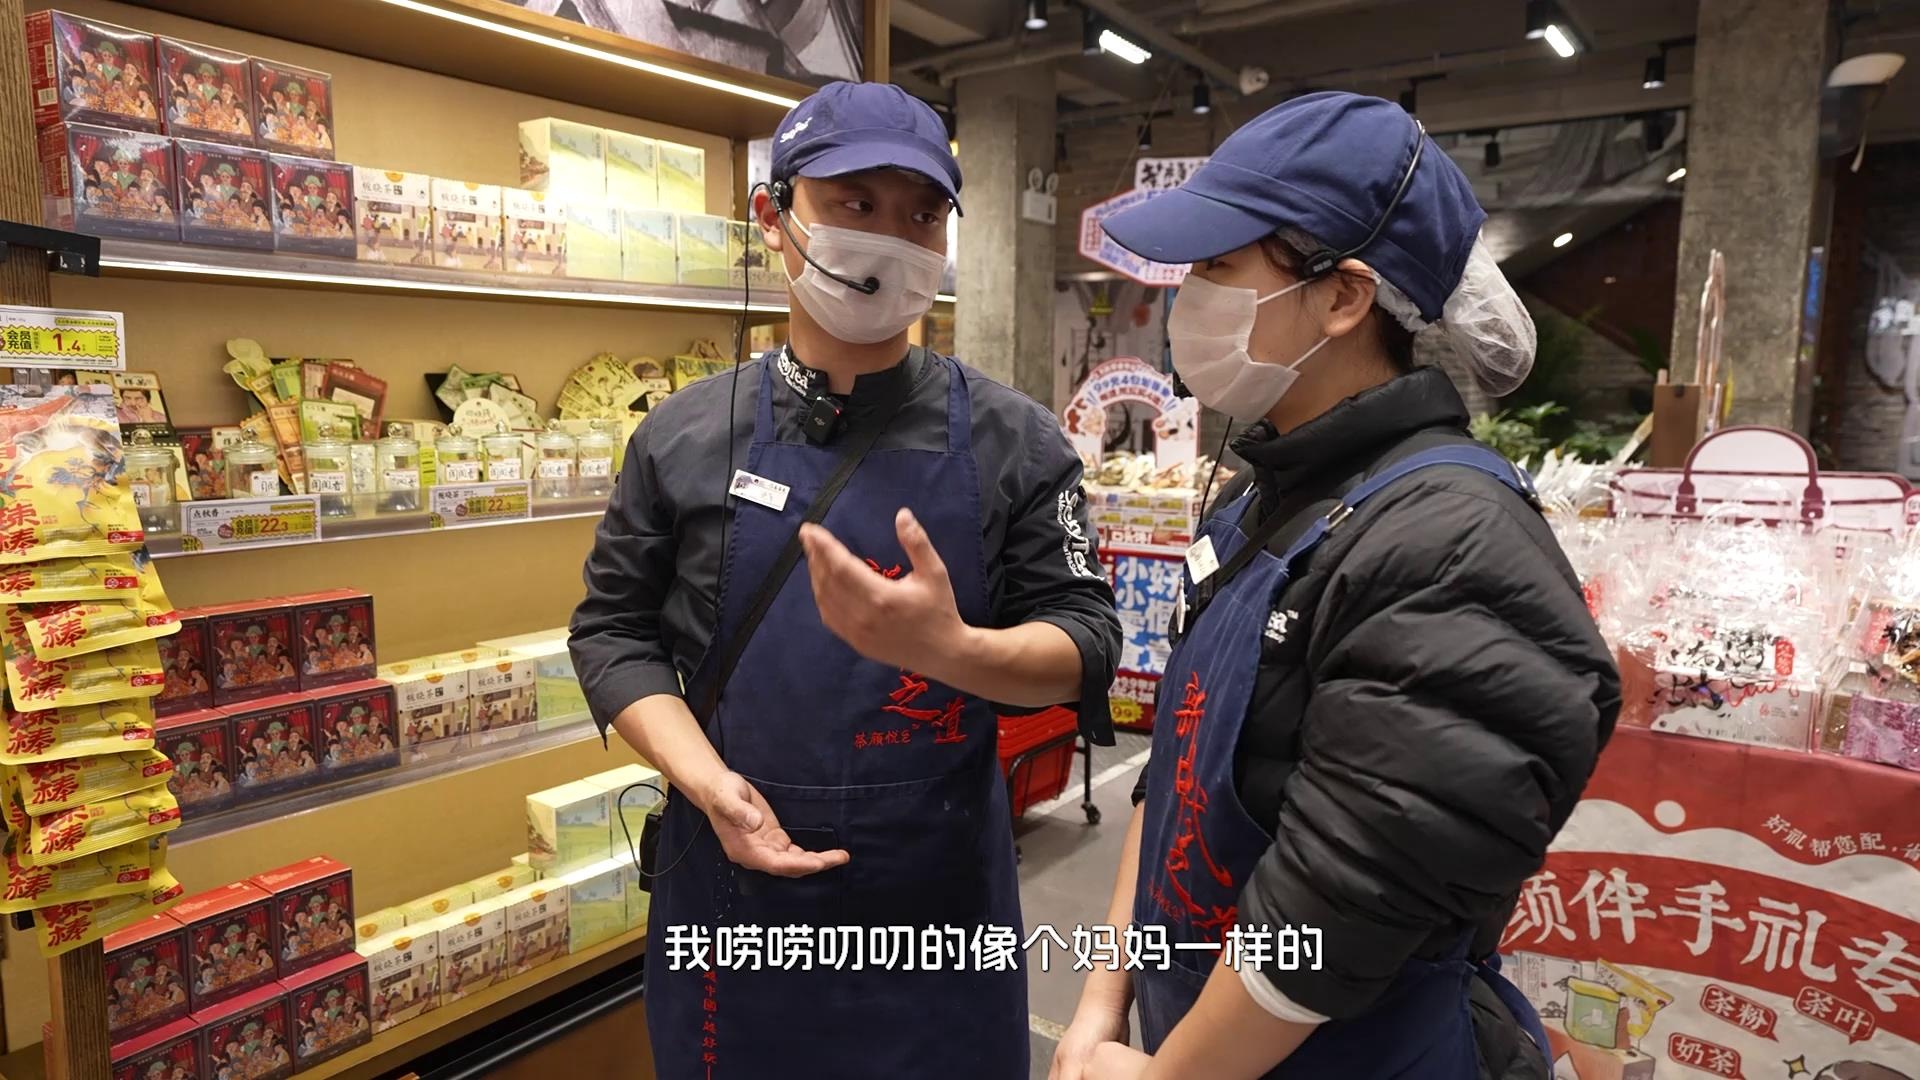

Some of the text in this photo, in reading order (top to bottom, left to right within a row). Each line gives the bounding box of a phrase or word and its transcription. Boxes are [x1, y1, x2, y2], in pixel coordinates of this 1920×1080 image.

[7, 329, 31, 340] 会员
[7, 340, 32, 350] 充值
[52, 333, 81, 352] 1.4
[1706, 988, 1769, 1031] 茶粉
[1802, 987, 1871, 1033] 茶叶
[1675, 1036, 1736, 1077] 奶茶
